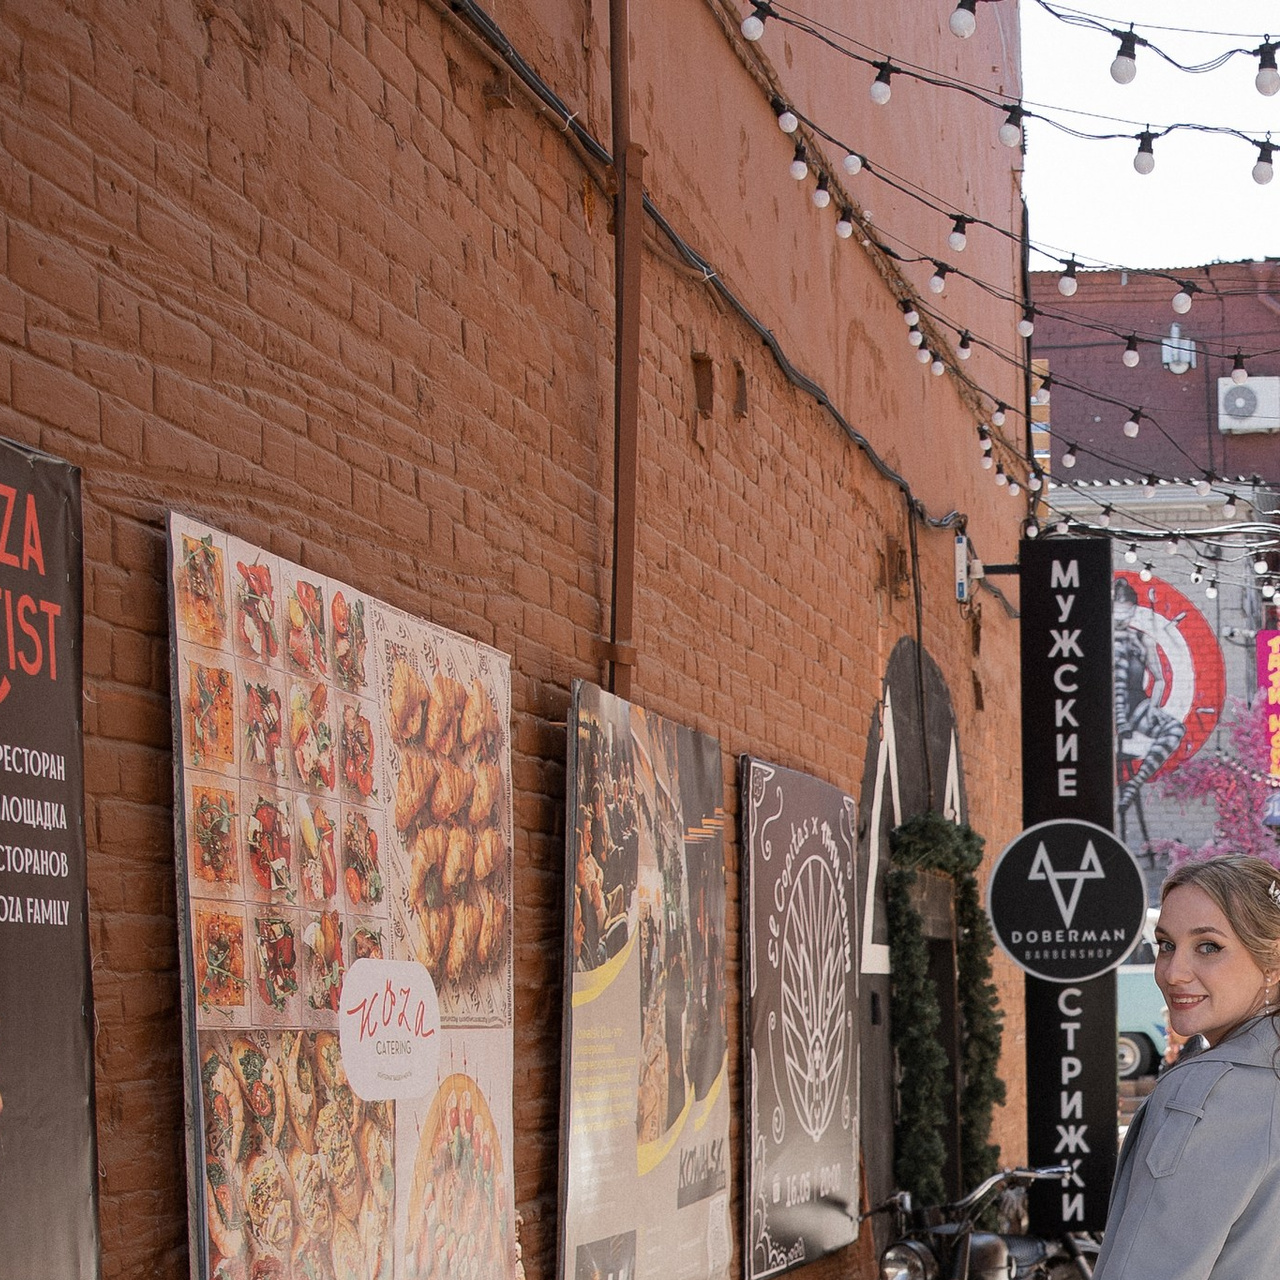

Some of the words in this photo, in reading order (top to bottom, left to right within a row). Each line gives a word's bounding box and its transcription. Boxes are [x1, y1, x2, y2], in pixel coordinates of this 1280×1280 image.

[0, 588, 61, 681] IST
[1047, 559, 1084, 797] МУЖСКИЕ
[26, 897, 70, 926] FAMILY
[1011, 928, 1126, 944] DOBERMAN
[1025, 949, 1112, 960] BARBERSHOP
[375, 1040, 411, 1055] CATERING
[1053, 987, 1090, 1222] СТРИЖКИ
